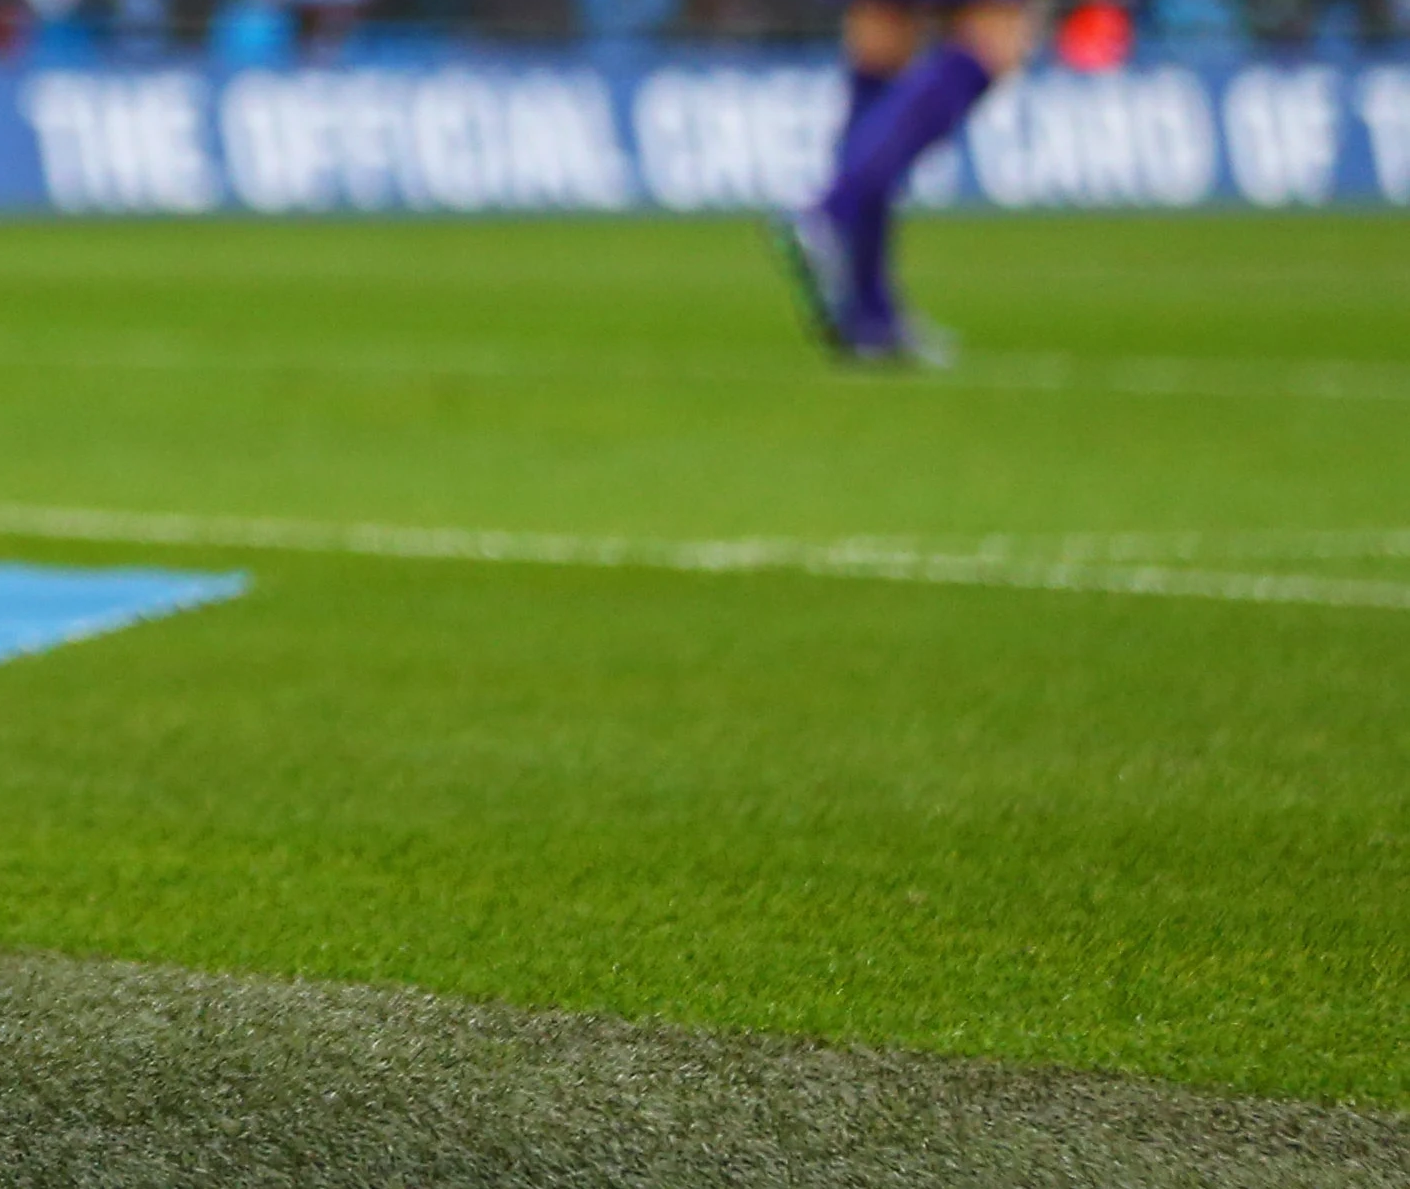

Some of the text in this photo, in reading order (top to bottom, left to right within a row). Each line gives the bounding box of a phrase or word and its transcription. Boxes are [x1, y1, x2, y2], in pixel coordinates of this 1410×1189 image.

[20, 68, 217, 211] THE
[224, 68, 628, 211] OFFICIAL
[1224, 67, 1340, 207] OF
